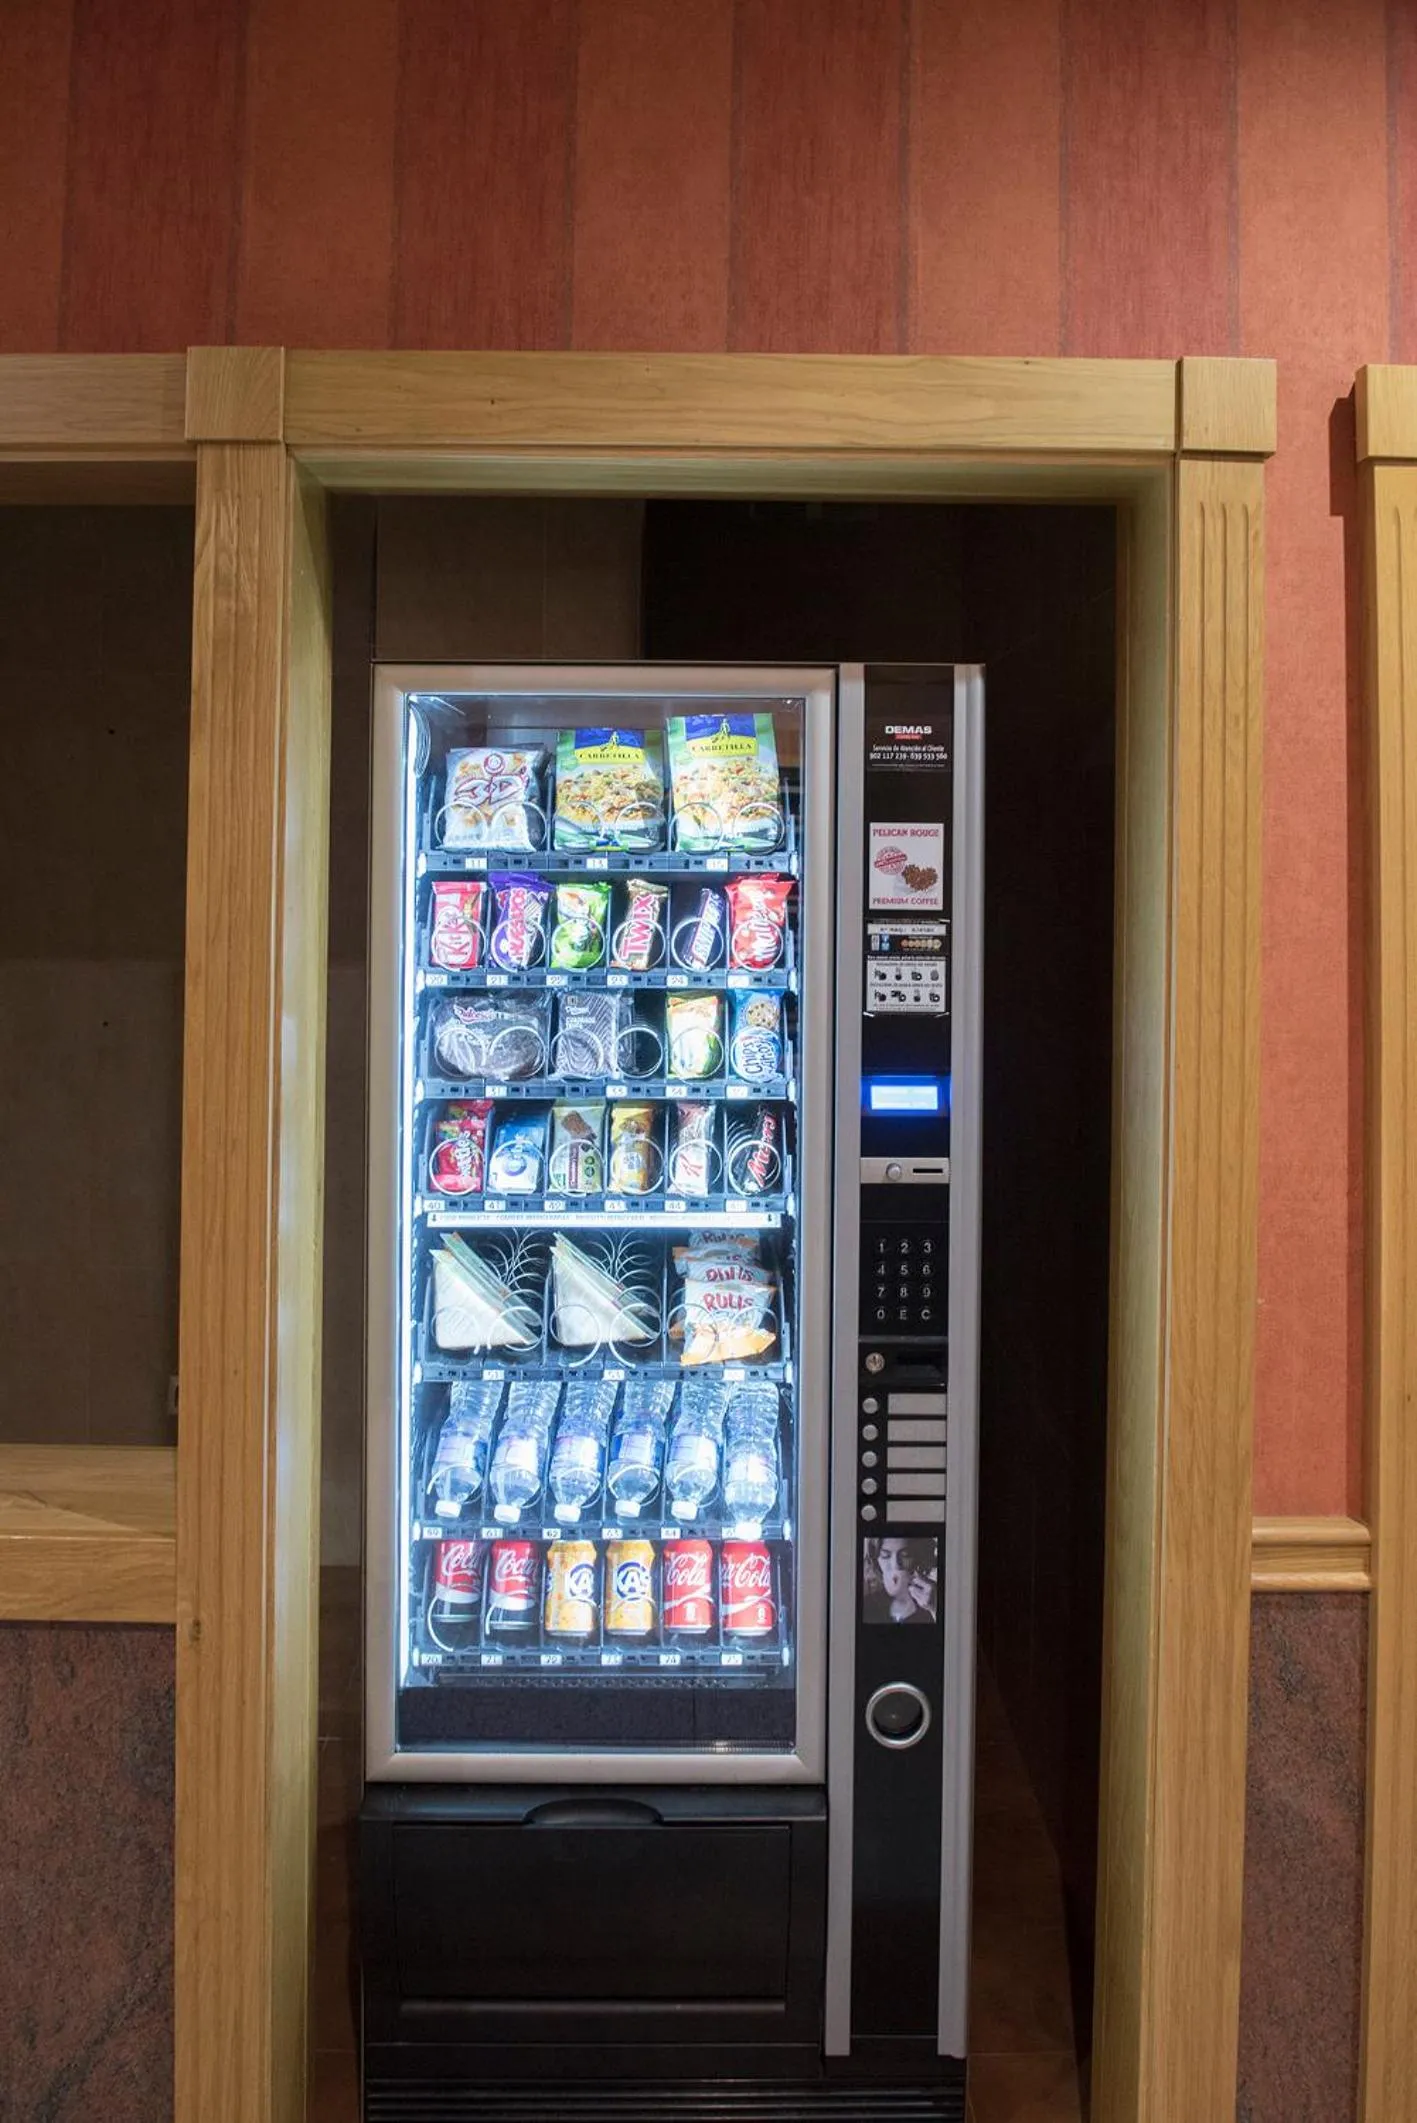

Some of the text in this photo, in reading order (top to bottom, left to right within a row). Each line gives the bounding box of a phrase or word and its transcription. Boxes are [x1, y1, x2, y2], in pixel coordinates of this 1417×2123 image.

[885, 725, 932, 734] DEMAS
[872, 828, 939, 837] PELICAN ROUGE
[872, 897, 938, 905] PREMIUM COFFEE
[879, 1242, 884, 1253] 1
[901, 1242, 909, 1253] 2
[923, 1242, 931, 1253] 3
[878, 1264, 885, 1275] 4
[901, 1264, 908, 1275] 5
[922, 1264, 930, 1275] 6
[878, 1287, 884, 1298] 7
[900, 1287, 908, 1298] 8
[923, 1287, 931, 1298] 9
[877, 1309, 885, 1320] 0
[900, 1309, 907, 1320] E
[921, 1309, 931, 1320] C
[667, 1553, 707, 1586] Cola
[734, 1553, 771, 1589] Cola
